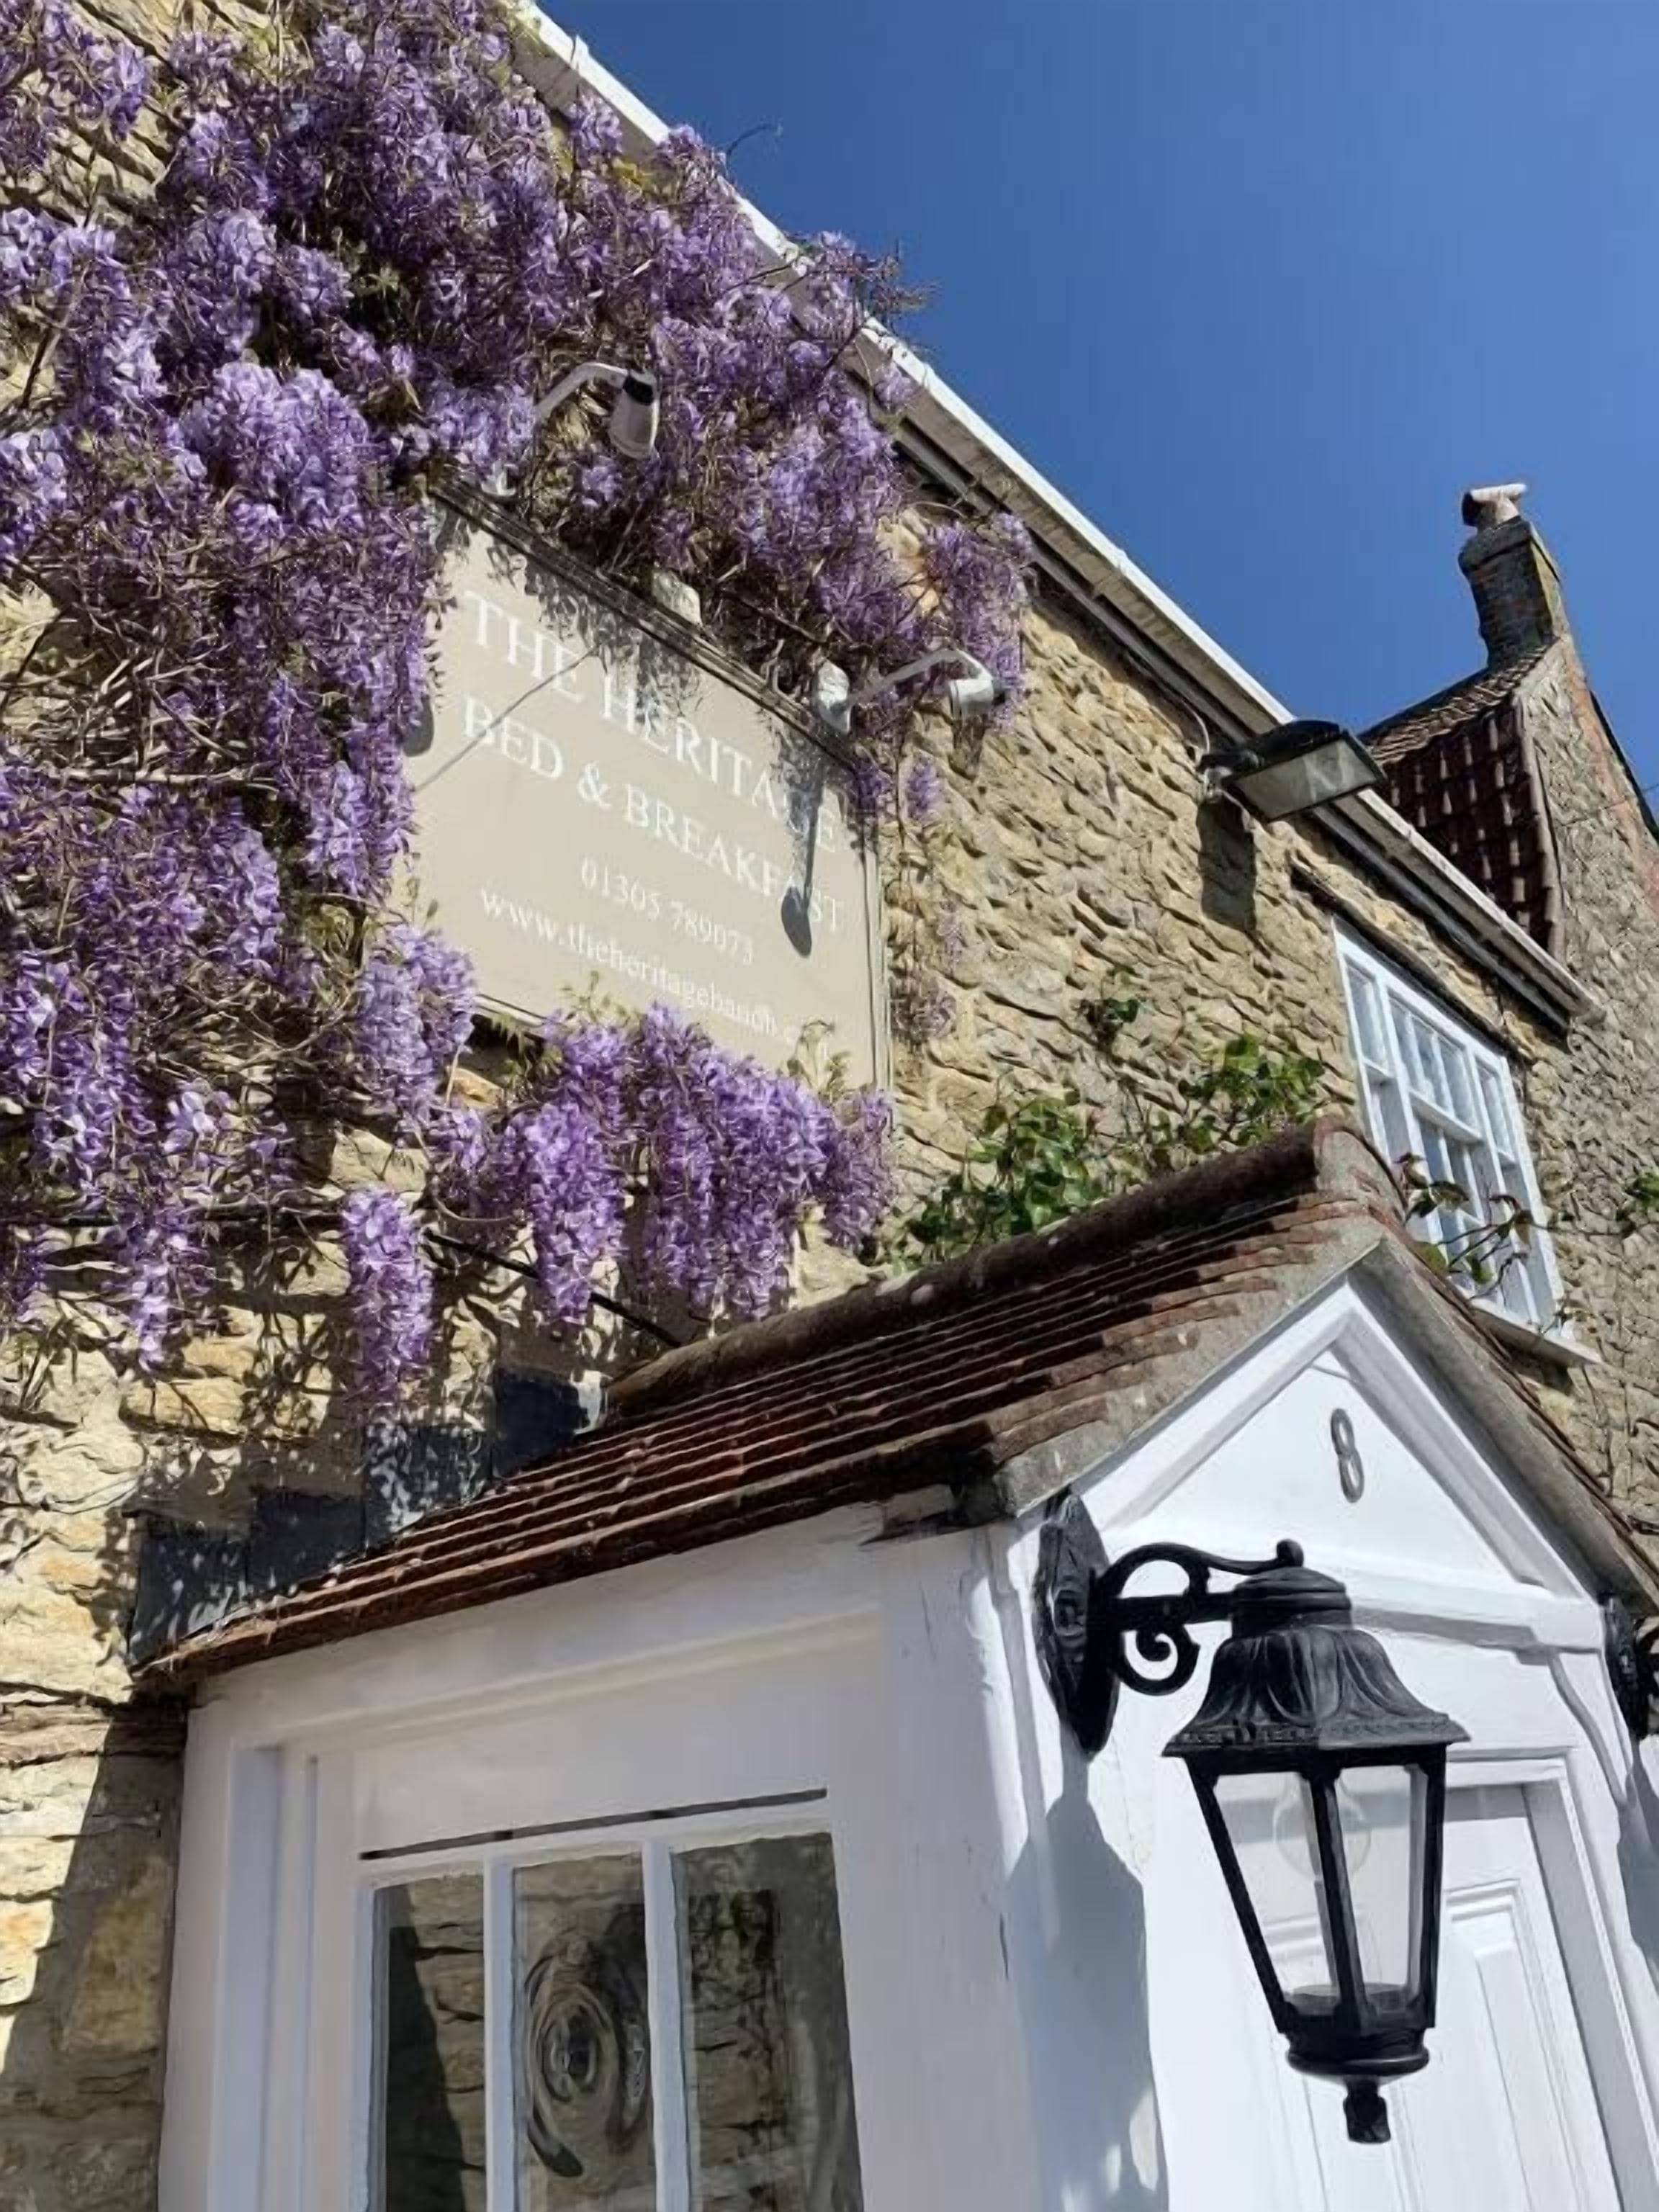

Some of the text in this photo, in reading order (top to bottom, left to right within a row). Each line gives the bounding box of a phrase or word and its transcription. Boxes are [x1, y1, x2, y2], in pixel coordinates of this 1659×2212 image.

[464, 590, 586, 703] THE
[463, 693, 563, 779] BED
[576, 760, 611, 811] &
[581, 857, 660, 920] 01305
[1330, 1408, 1364, 1503] 8
